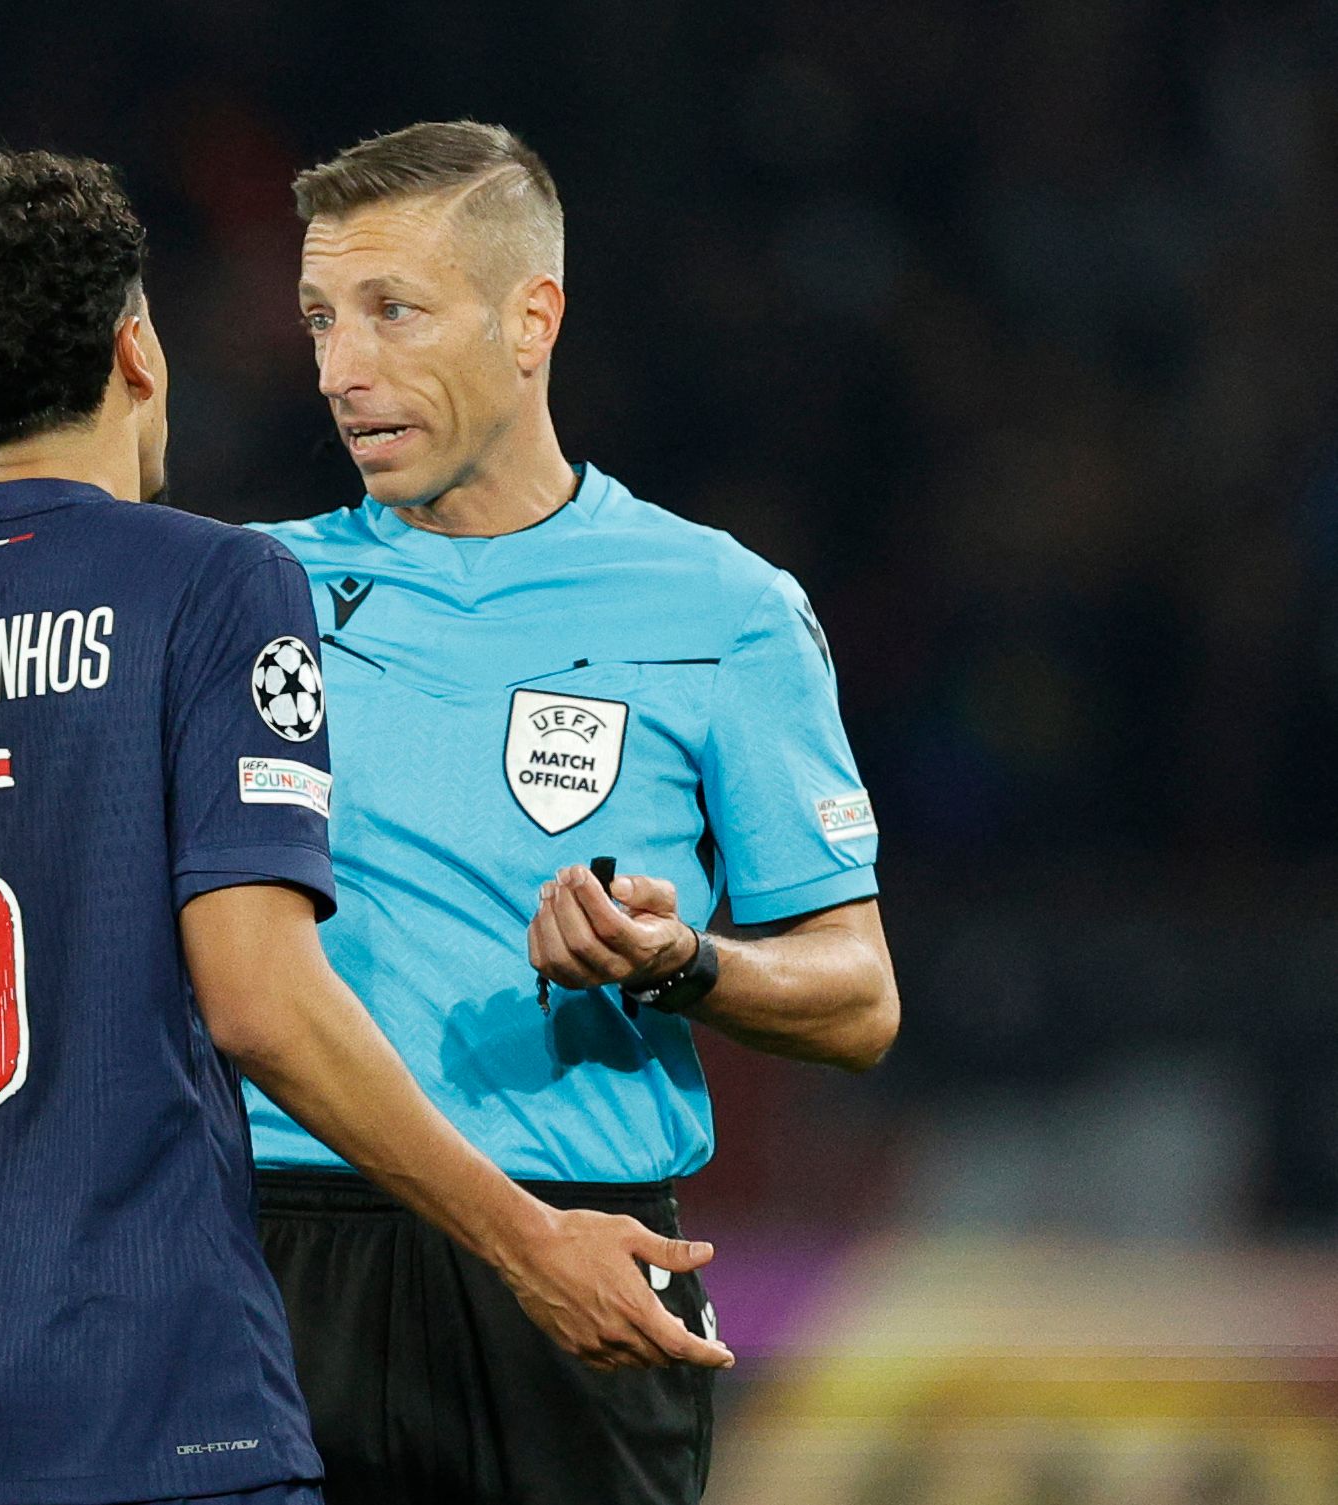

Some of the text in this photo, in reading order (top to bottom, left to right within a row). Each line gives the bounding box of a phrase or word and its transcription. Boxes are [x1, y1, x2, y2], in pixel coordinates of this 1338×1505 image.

[533, 711, 599, 739] UEFA
[243, 761, 268, 770] UEFA
[529, 750, 596, 771] MATCH
[244, 772, 328, 804] FOUNDATION
[519, 770, 599, 793] OFFICIAL
